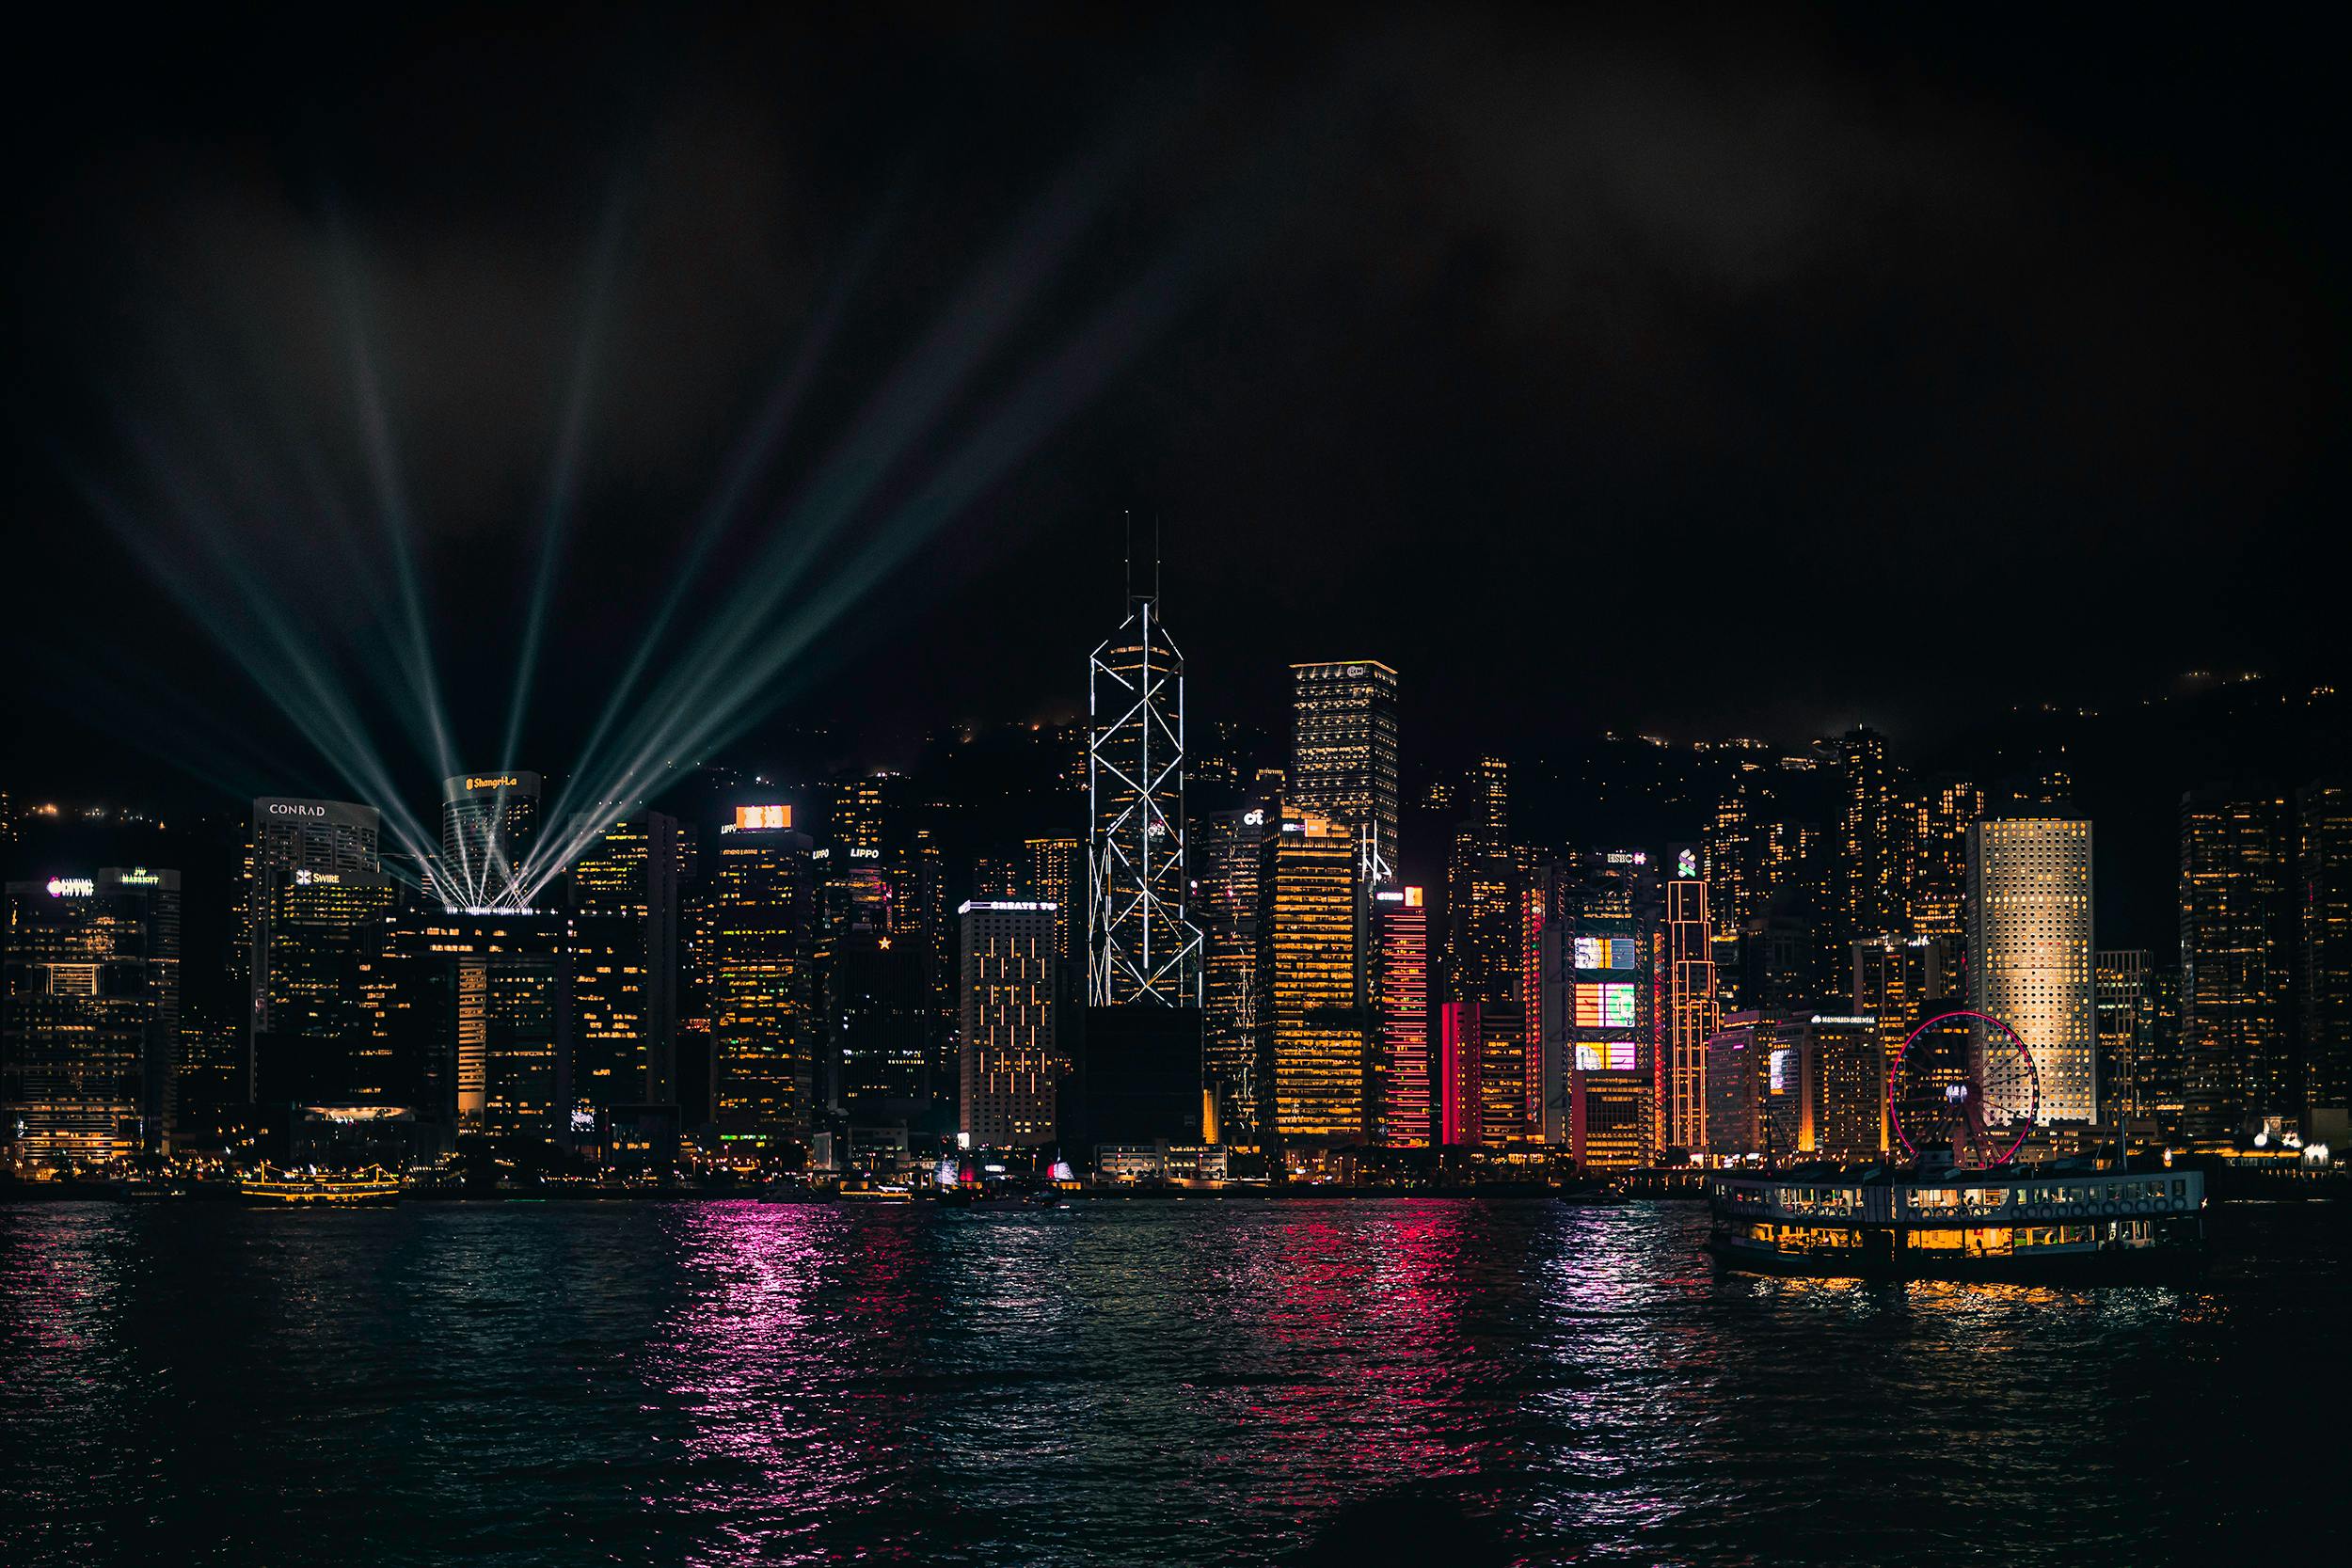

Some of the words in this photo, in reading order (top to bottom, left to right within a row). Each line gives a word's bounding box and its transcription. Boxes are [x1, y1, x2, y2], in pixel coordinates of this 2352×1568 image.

[473, 776, 517, 789] Shangri-La
[269, 804, 326, 816] CONRAD
[721, 824, 737, 834] LIPPO
[812, 848, 830, 860] LIPPO
[850, 848, 879, 859] LIPPO
[1607, 853, 1633, 863] HSBC
[121, 875, 159, 884] MARRIOTT
[991, 901, 1038, 911] CREATE
